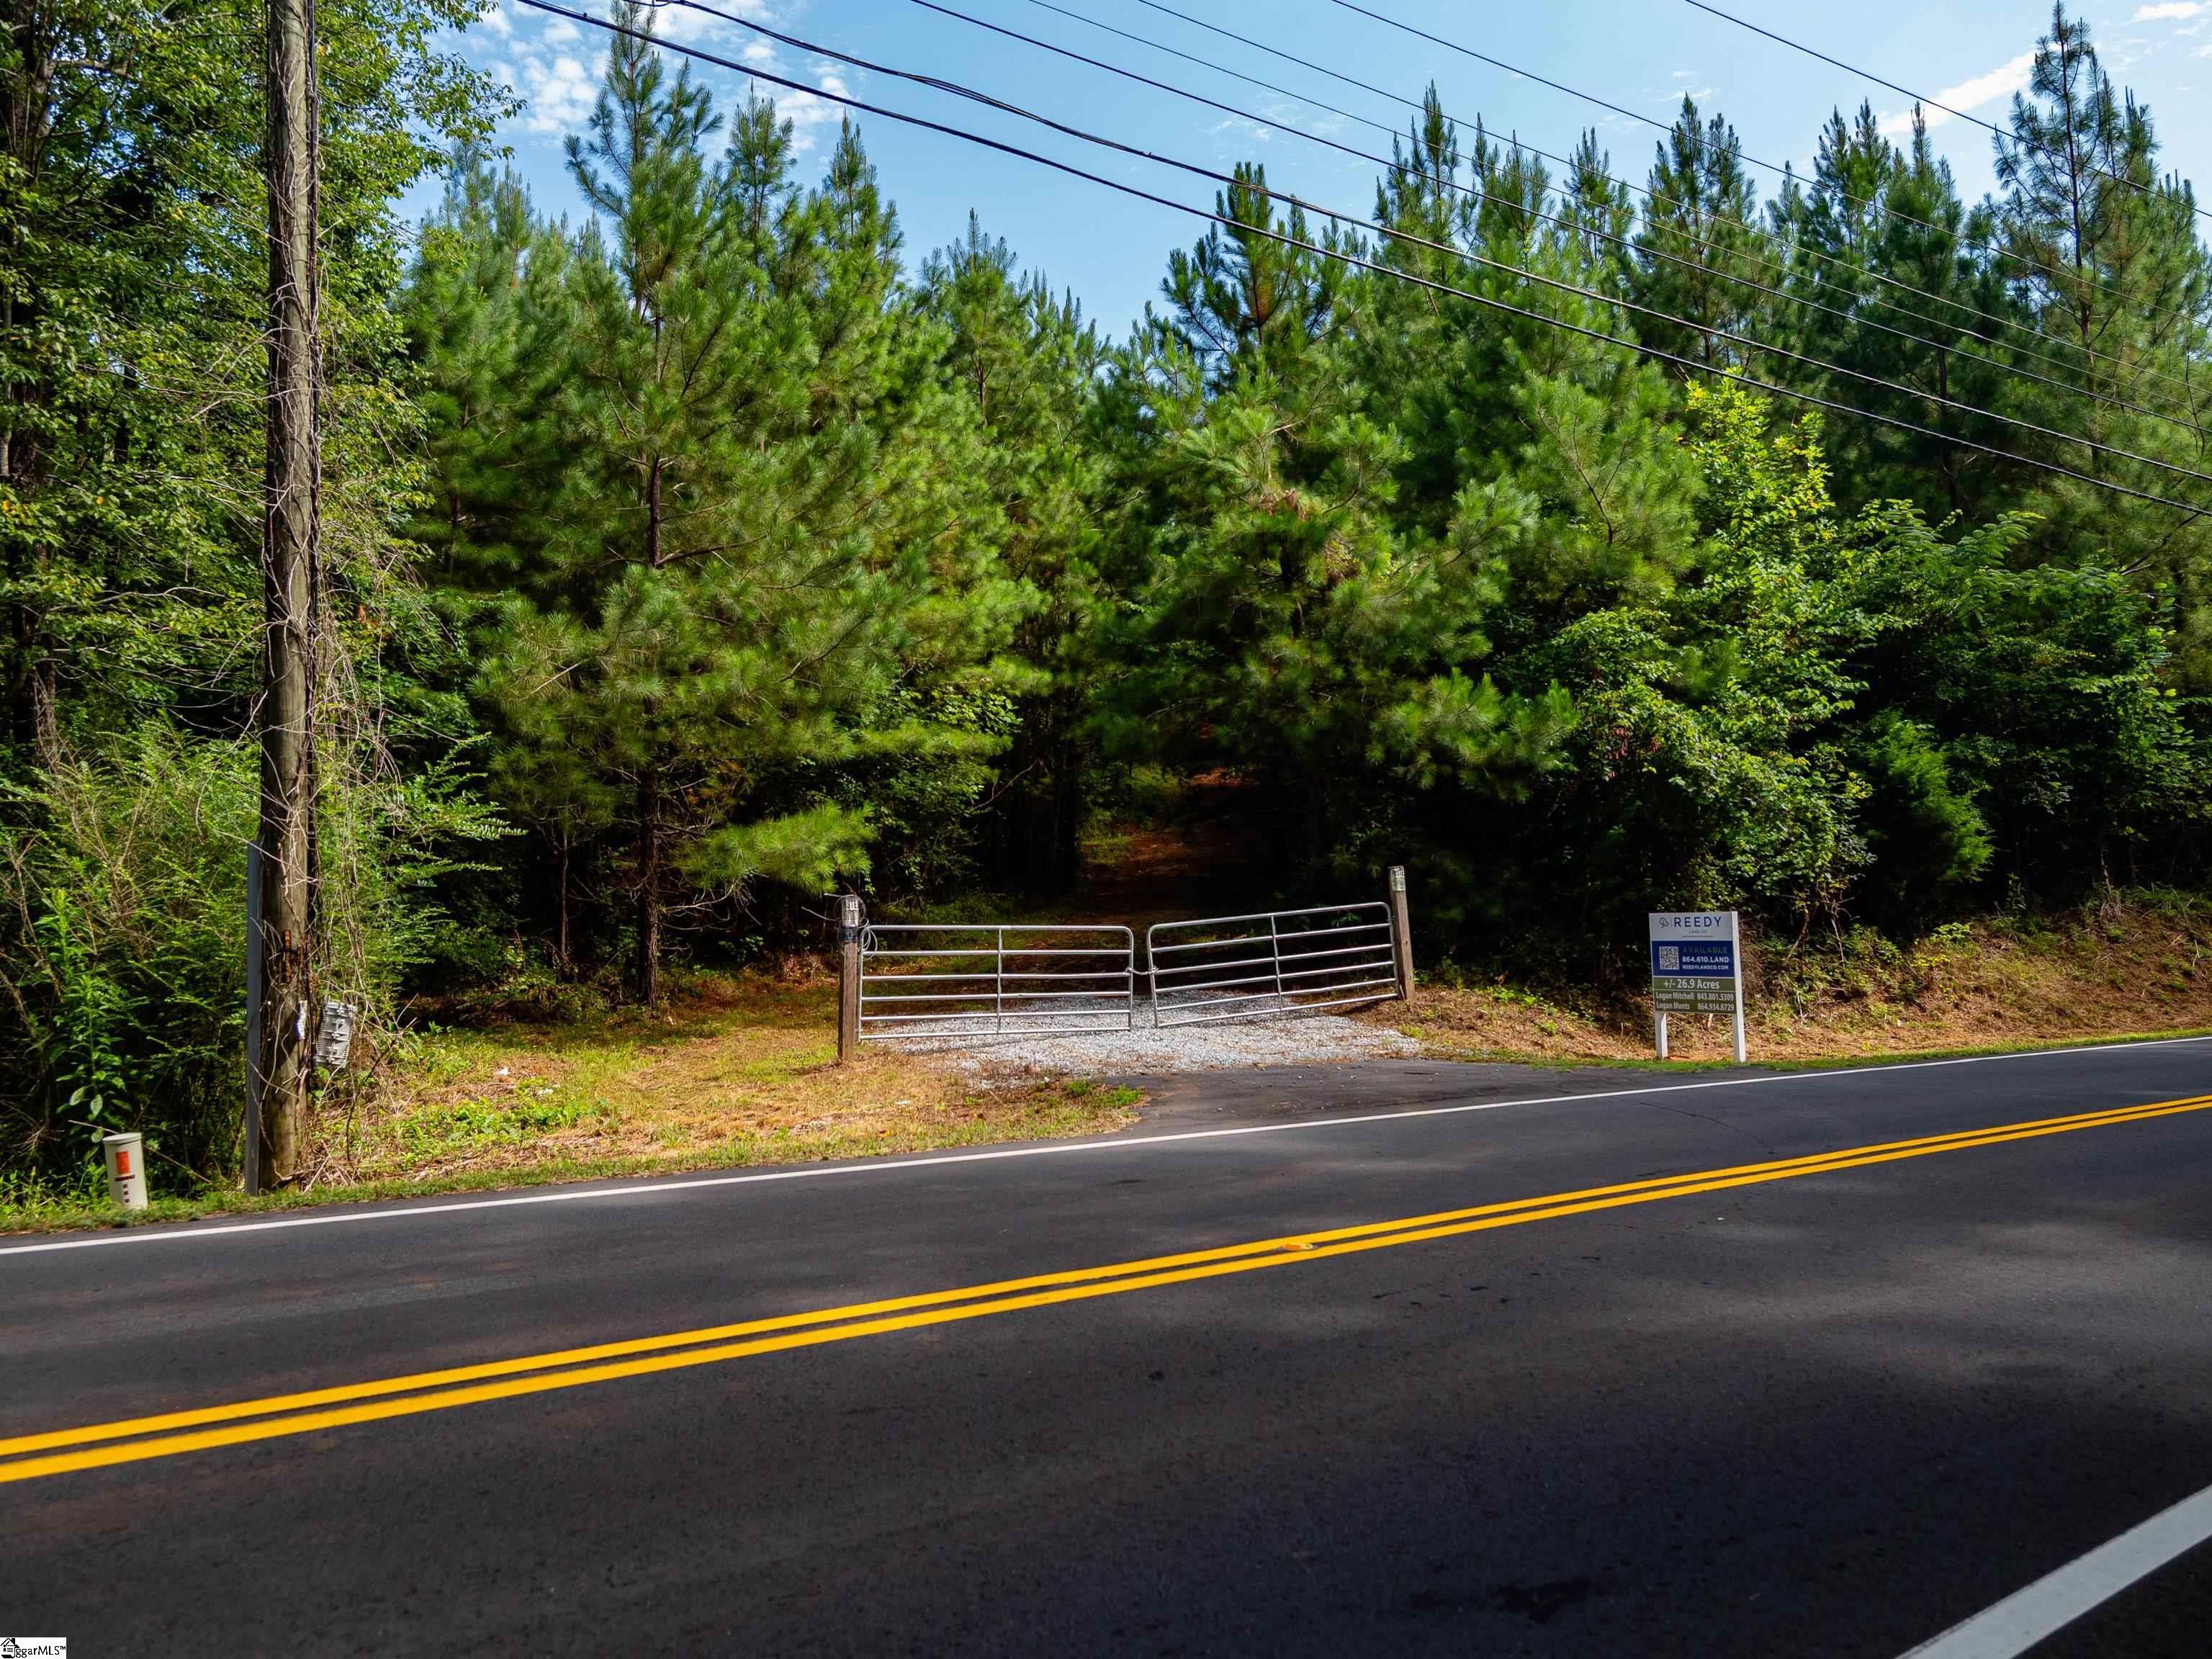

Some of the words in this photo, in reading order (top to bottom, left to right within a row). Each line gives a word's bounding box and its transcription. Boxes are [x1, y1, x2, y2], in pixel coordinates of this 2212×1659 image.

[1674, 916, 1722, 927] REEDY
[1663, 979, 1676, 988] +/-
[1677, 979, 1695, 989] 26.9
[1696, 979, 1720, 989] Acres
[1656, 992, 1672, 1000] Logan
[1656, 1002, 1672, 1010] Logan
